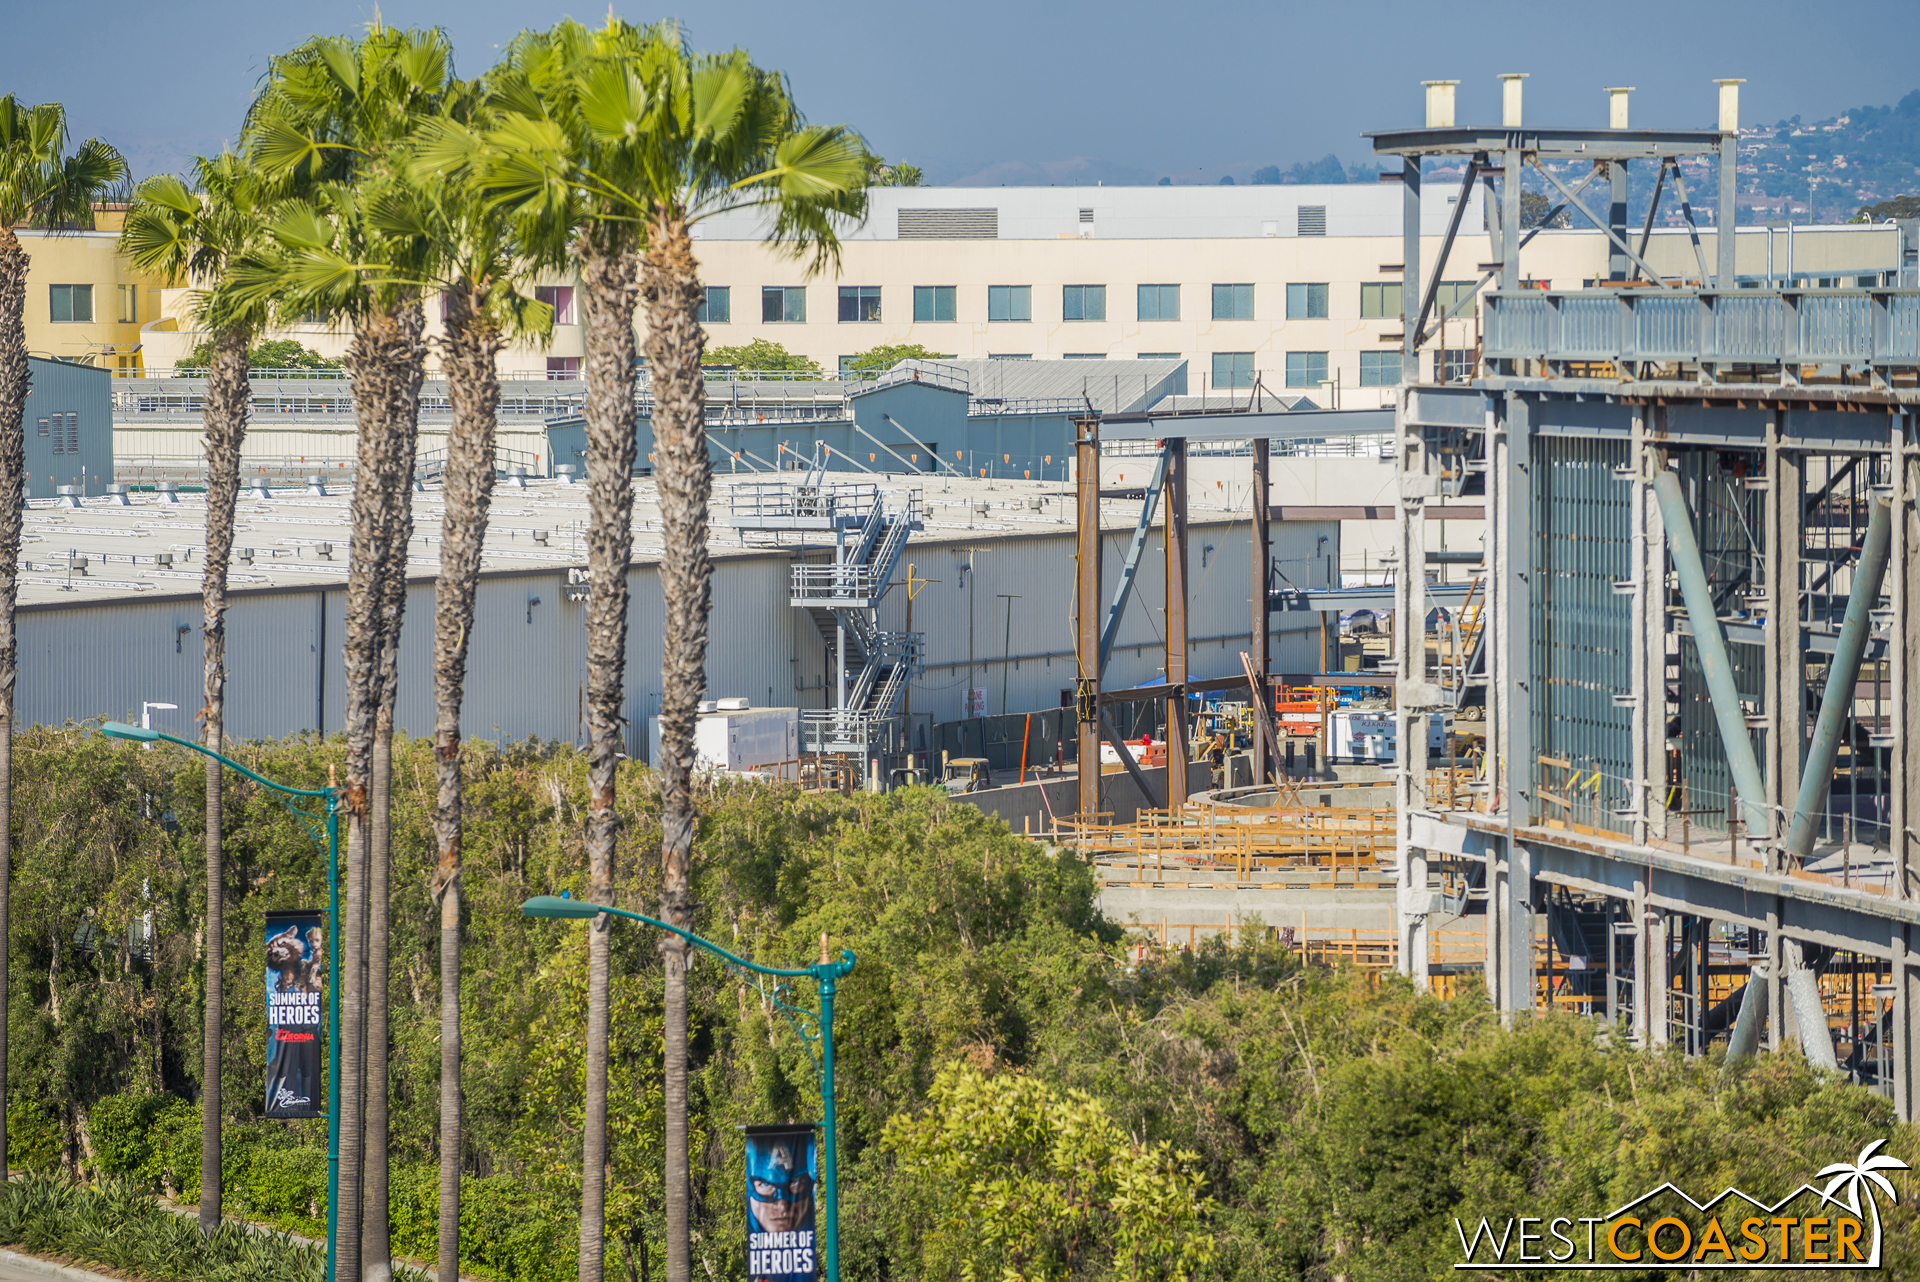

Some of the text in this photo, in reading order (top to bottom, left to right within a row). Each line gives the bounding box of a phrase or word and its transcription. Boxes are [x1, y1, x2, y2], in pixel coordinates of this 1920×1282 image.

[964, 701, 985, 713] PKING
[269, 992, 320, 1005] SUMMER OF
[269, 1005, 320, 1025] HEROES
[749, 1230, 814, 1250] SUMMER OF
[749, 1247, 814, 1276] HEROES
